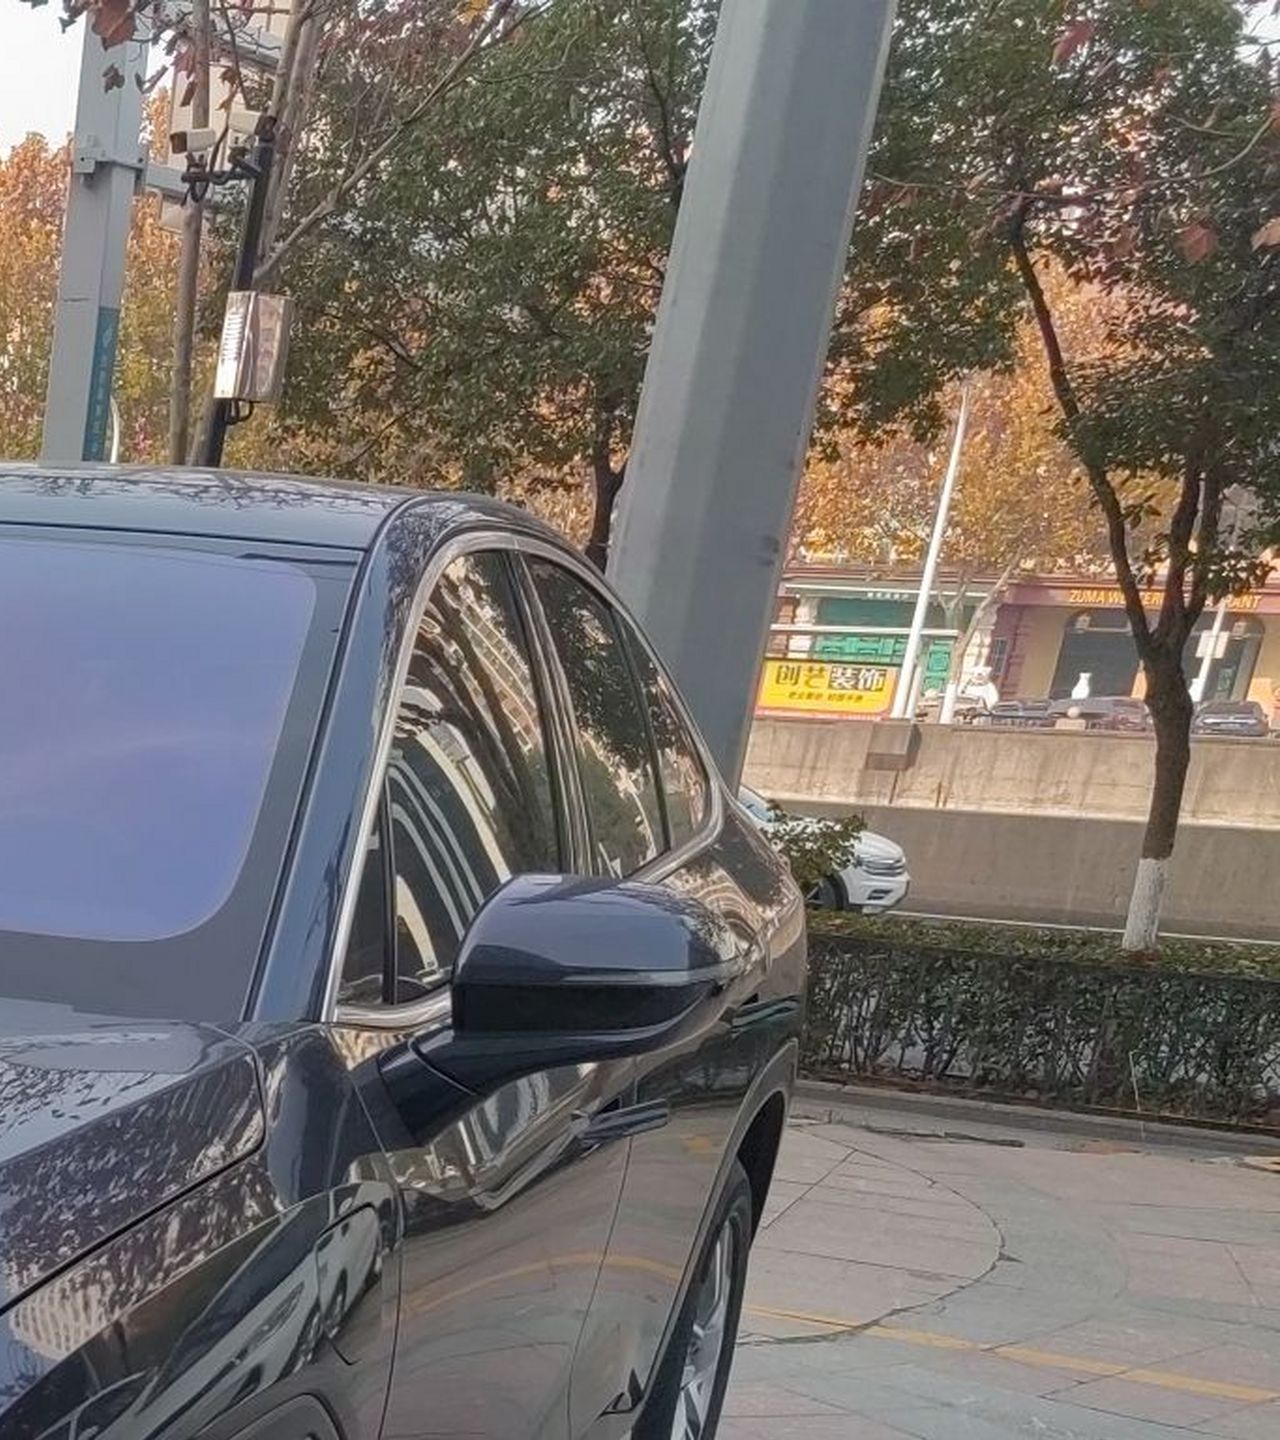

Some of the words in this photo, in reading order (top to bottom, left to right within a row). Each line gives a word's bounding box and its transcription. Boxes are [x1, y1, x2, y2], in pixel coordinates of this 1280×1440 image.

[1069, 589, 1105, 604] ZUMA
[775, 664, 888, 692] 创艺装饰
